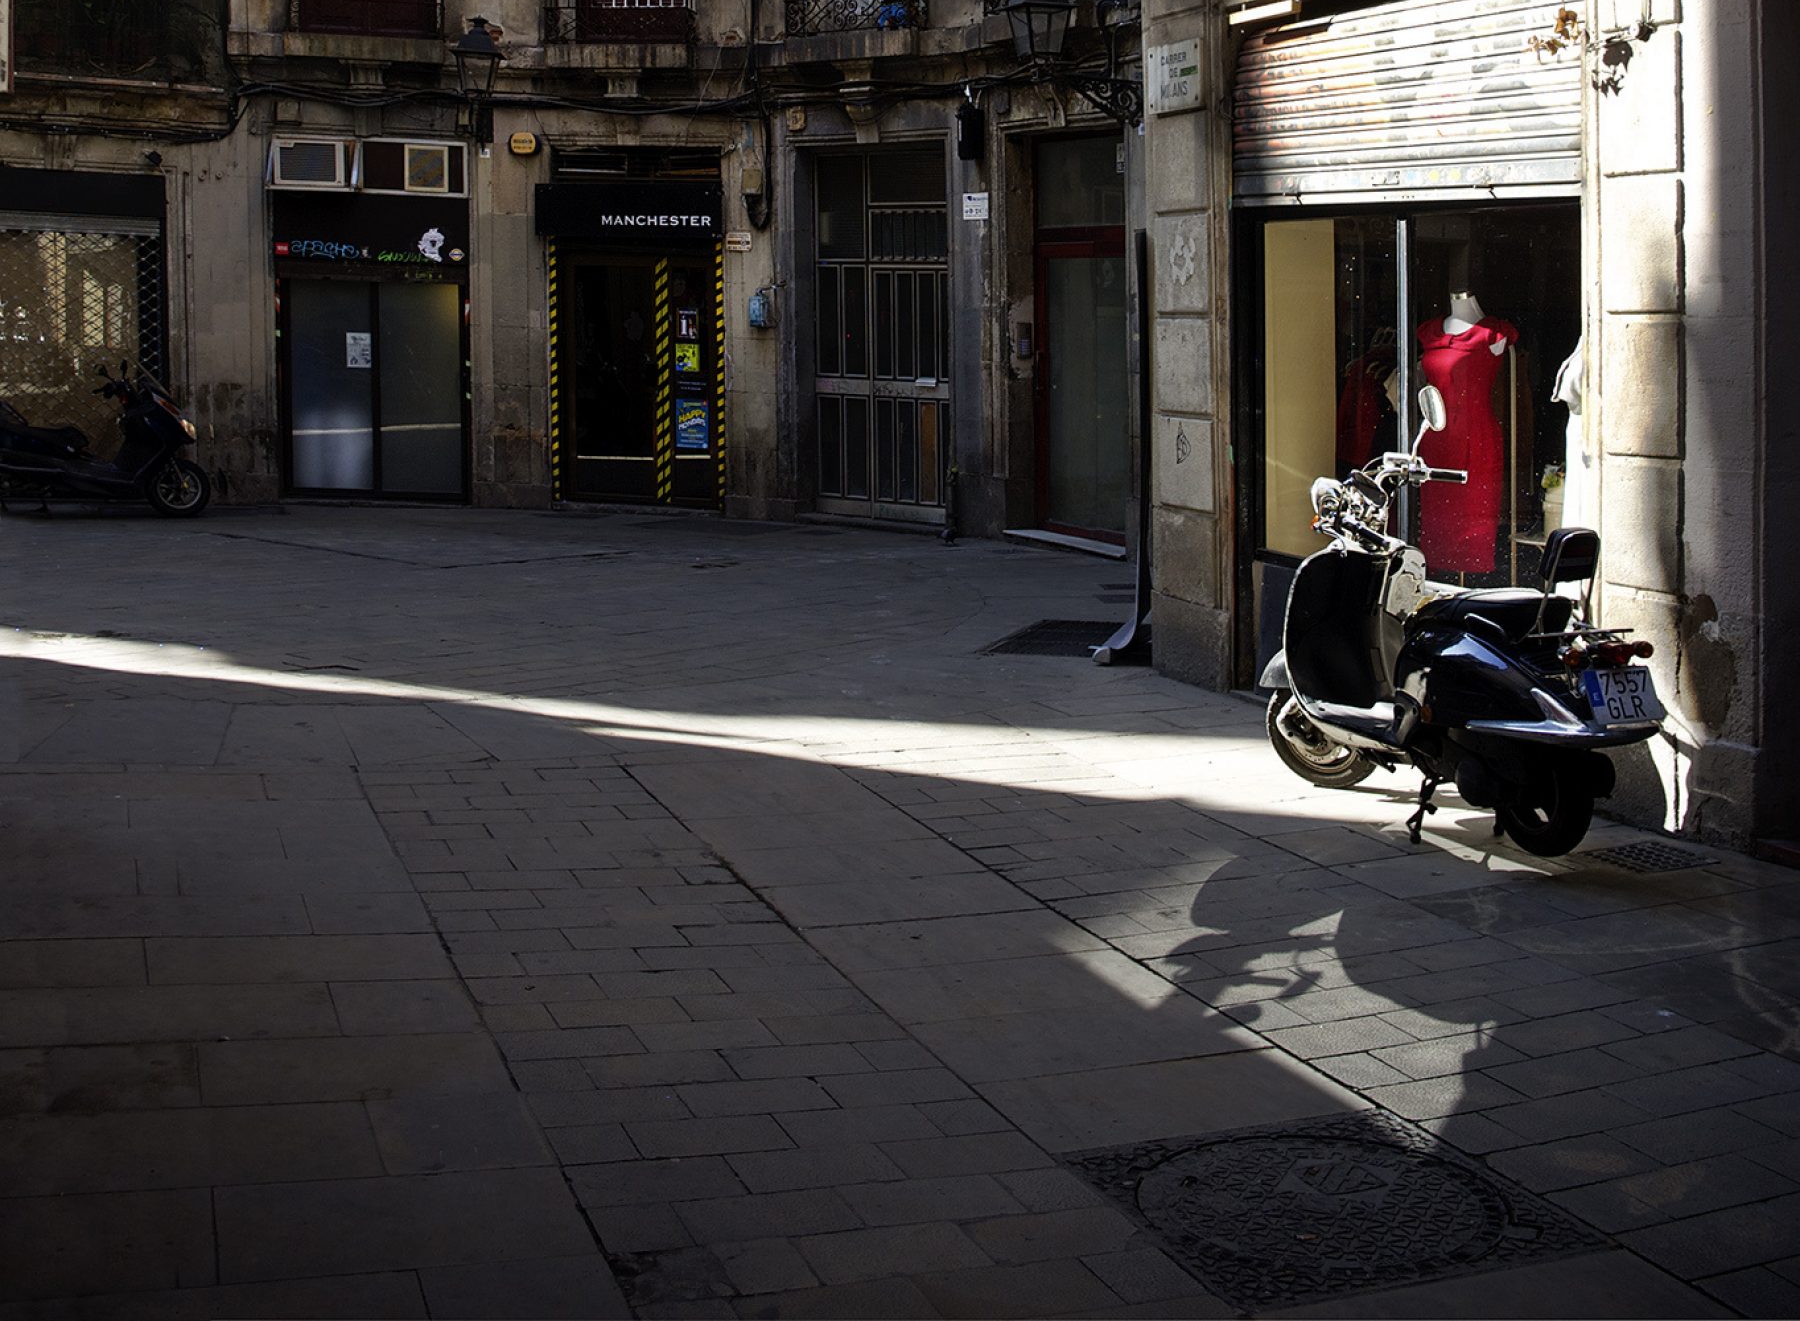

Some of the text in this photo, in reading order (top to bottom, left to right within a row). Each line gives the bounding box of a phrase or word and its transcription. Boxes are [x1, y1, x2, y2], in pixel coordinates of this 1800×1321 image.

[1168, 67, 1178, 79] DE
[601, 215, 712, 226] MANCHESTER
[1599, 670, 1647, 695] 7557
[1606, 695, 1648, 719] GLR
